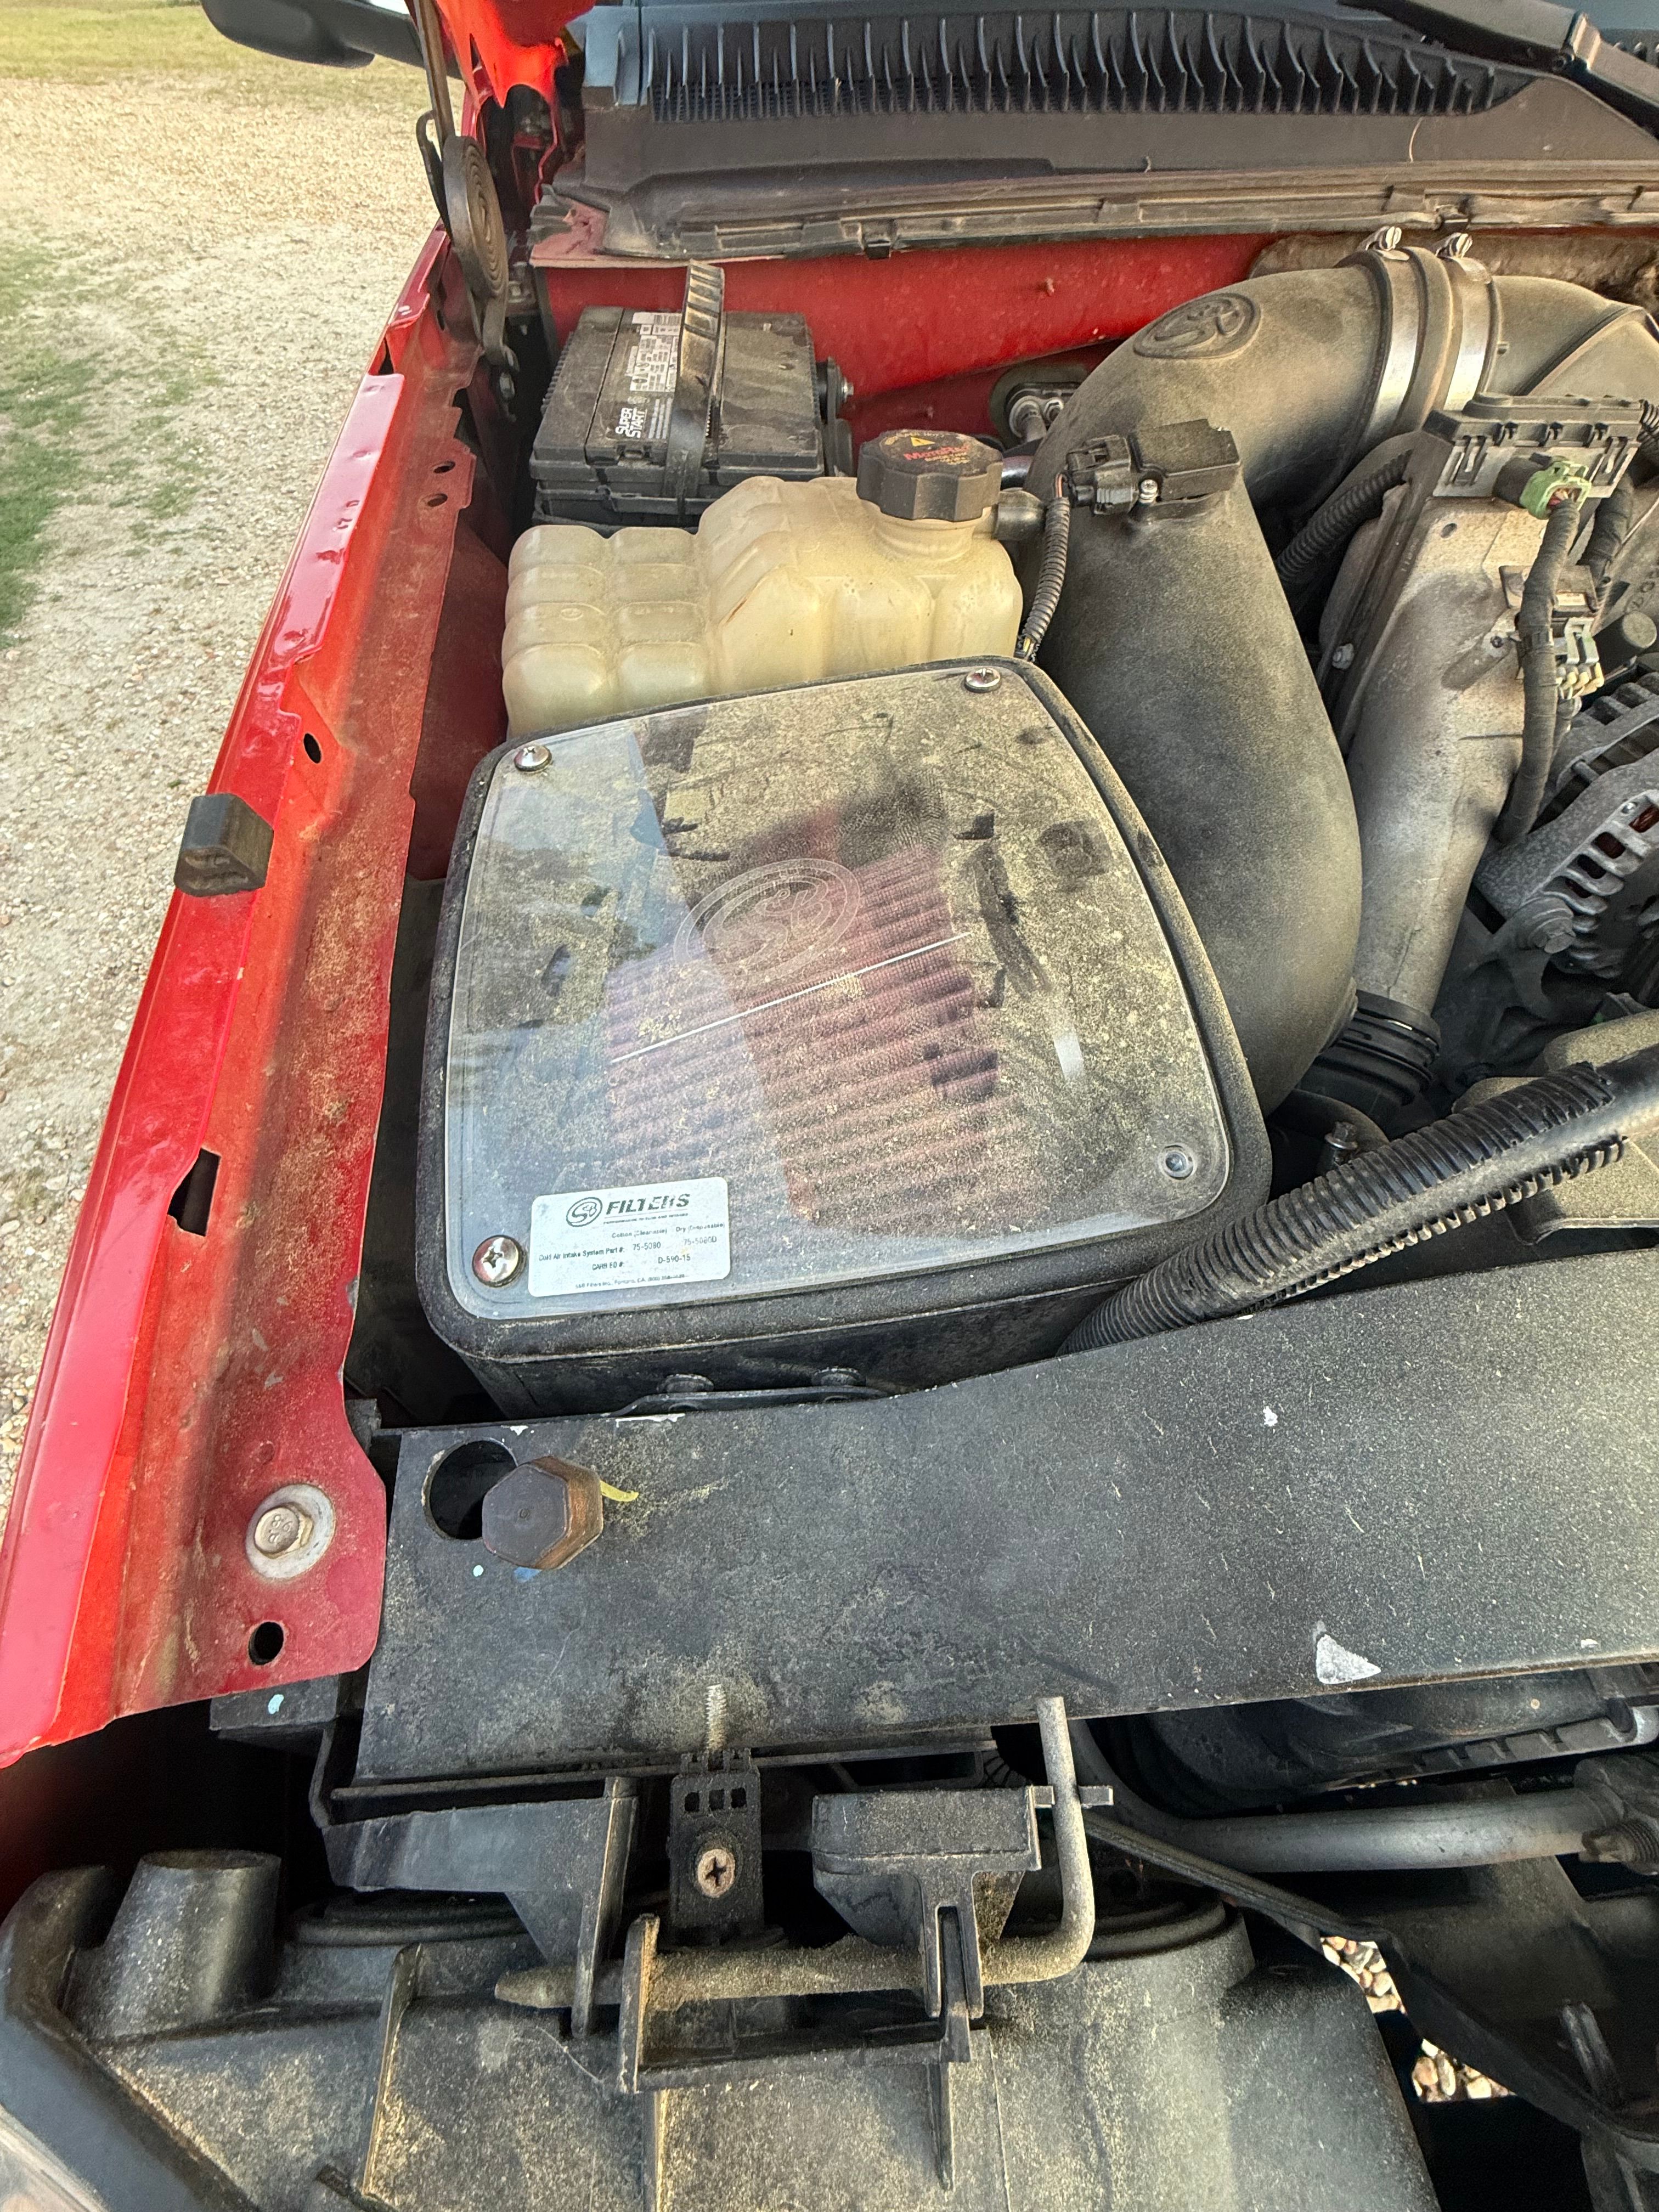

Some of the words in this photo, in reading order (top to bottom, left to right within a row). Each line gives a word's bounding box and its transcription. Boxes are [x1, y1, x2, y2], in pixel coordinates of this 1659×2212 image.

[615, 408, 633, 435] SUPER
[625, 407, 645, 438] START
[606, 1193, 690, 1215] FILTERS
[582, 1248, 604, 1258] System
[606, 1246, 617, 1255] Part
[632, 1241, 662, 1251] 75-5080
